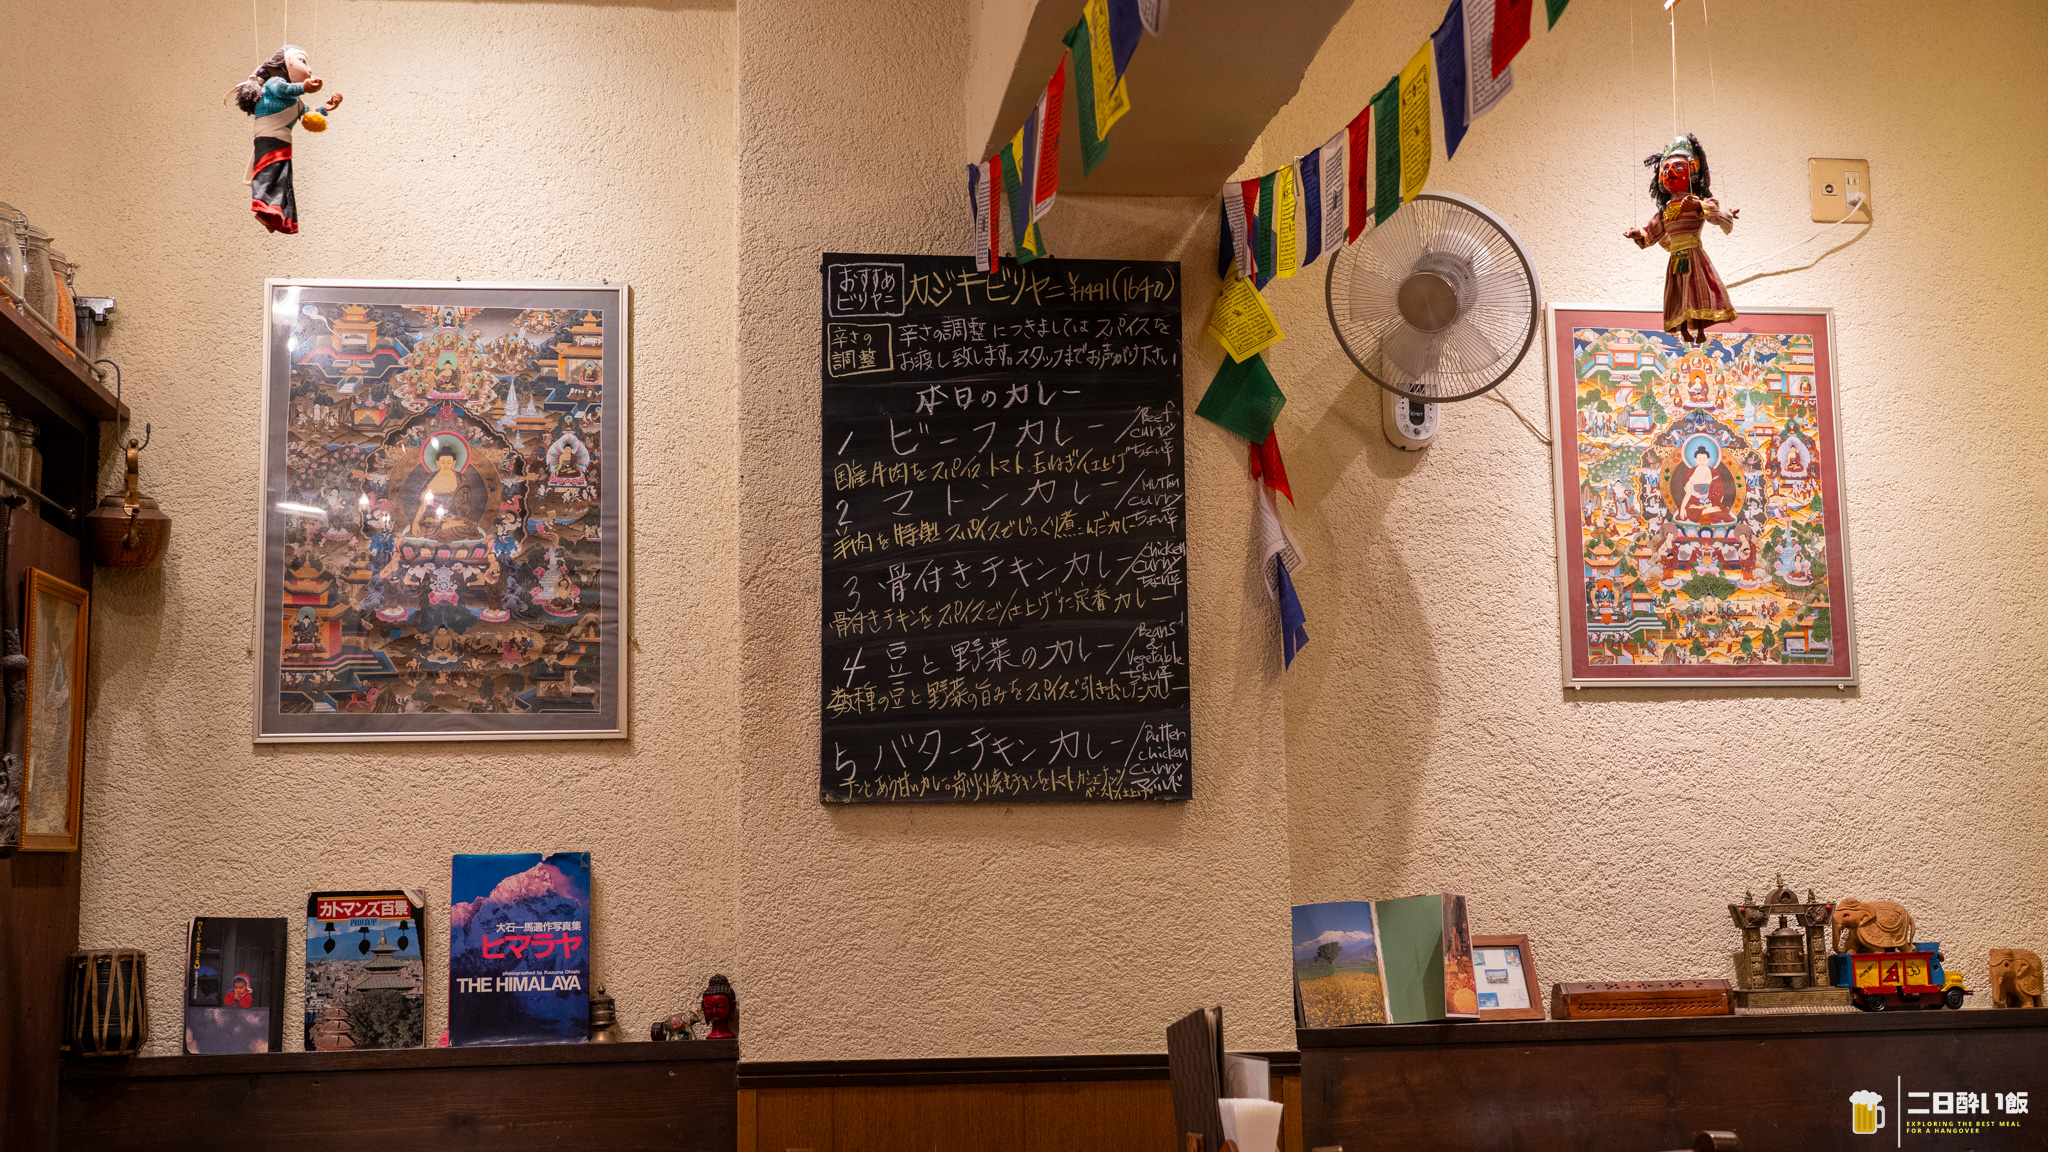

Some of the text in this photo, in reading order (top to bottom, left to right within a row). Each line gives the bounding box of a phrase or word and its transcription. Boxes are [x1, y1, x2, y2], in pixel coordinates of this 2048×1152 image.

[838, 267, 896, 293] おすすめ
[904, 266, 1065, 307] カジキビリヤニ
[837, 291, 896, 311] ビリヤニ
[831, 326, 872, 348] 辛さの
[831, 347, 877, 371] 調整
[914, 381, 1081, 415] 本日のカレー
[836, 500, 853, 526] 2
[843, 575, 861, 612] 3
[842, 647, 866, 688] 4
[835, 742, 857, 780] 5
[319, 900, 409, 918] カトマンズ百景
[496, 921, 582, 933] 大石一馬遺作写真集
[482, 932, 582, 959] ヒマラヤ
[456, 975, 582, 993] THE HIMALAYA
